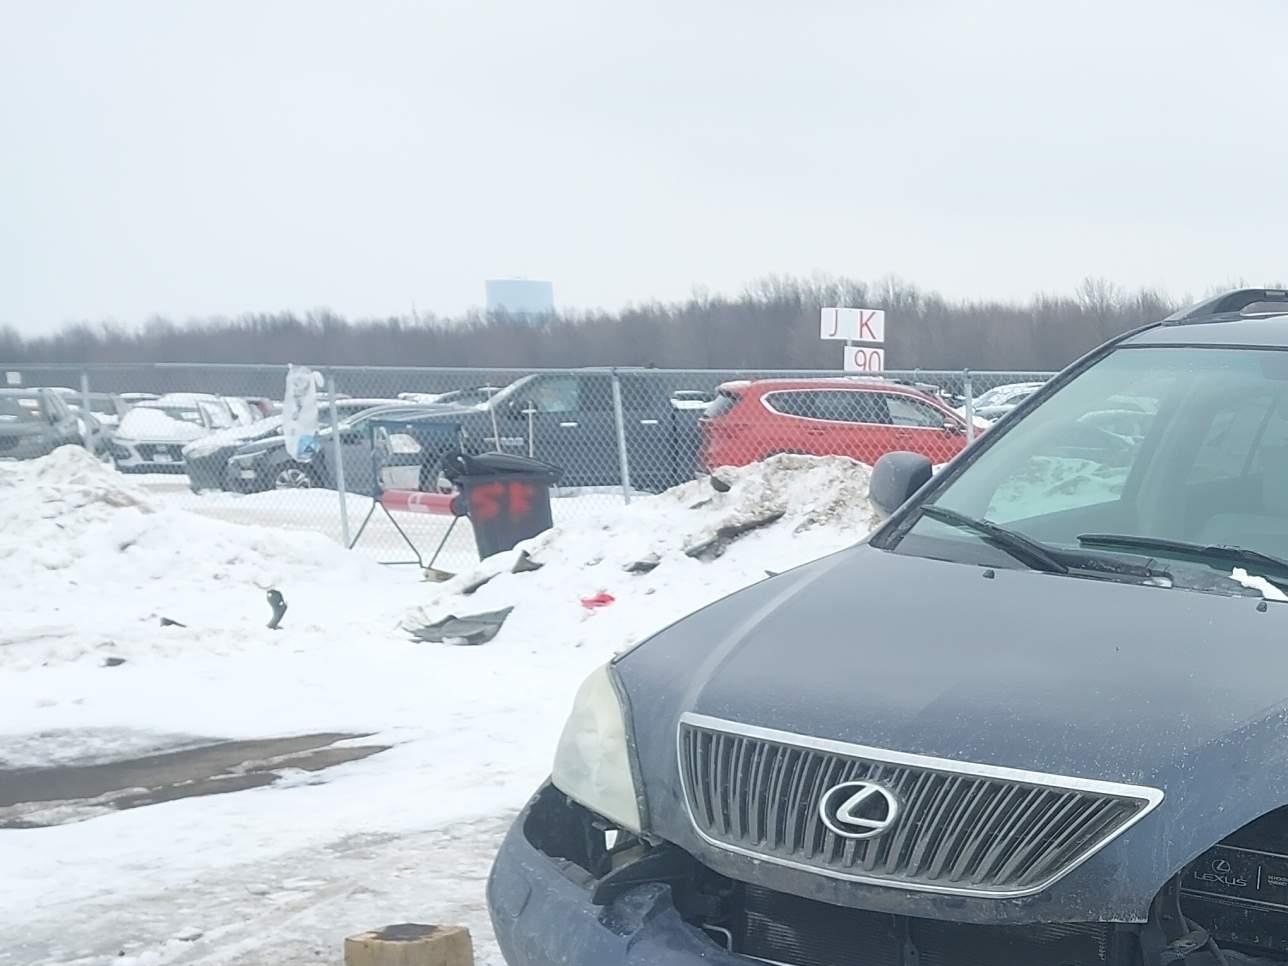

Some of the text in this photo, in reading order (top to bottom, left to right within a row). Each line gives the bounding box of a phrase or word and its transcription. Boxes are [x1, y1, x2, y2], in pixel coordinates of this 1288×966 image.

[828, 308, 877, 340] J K
[854, 349, 882, 378] 90
[1193, 871, 1248, 887] LEXUS
